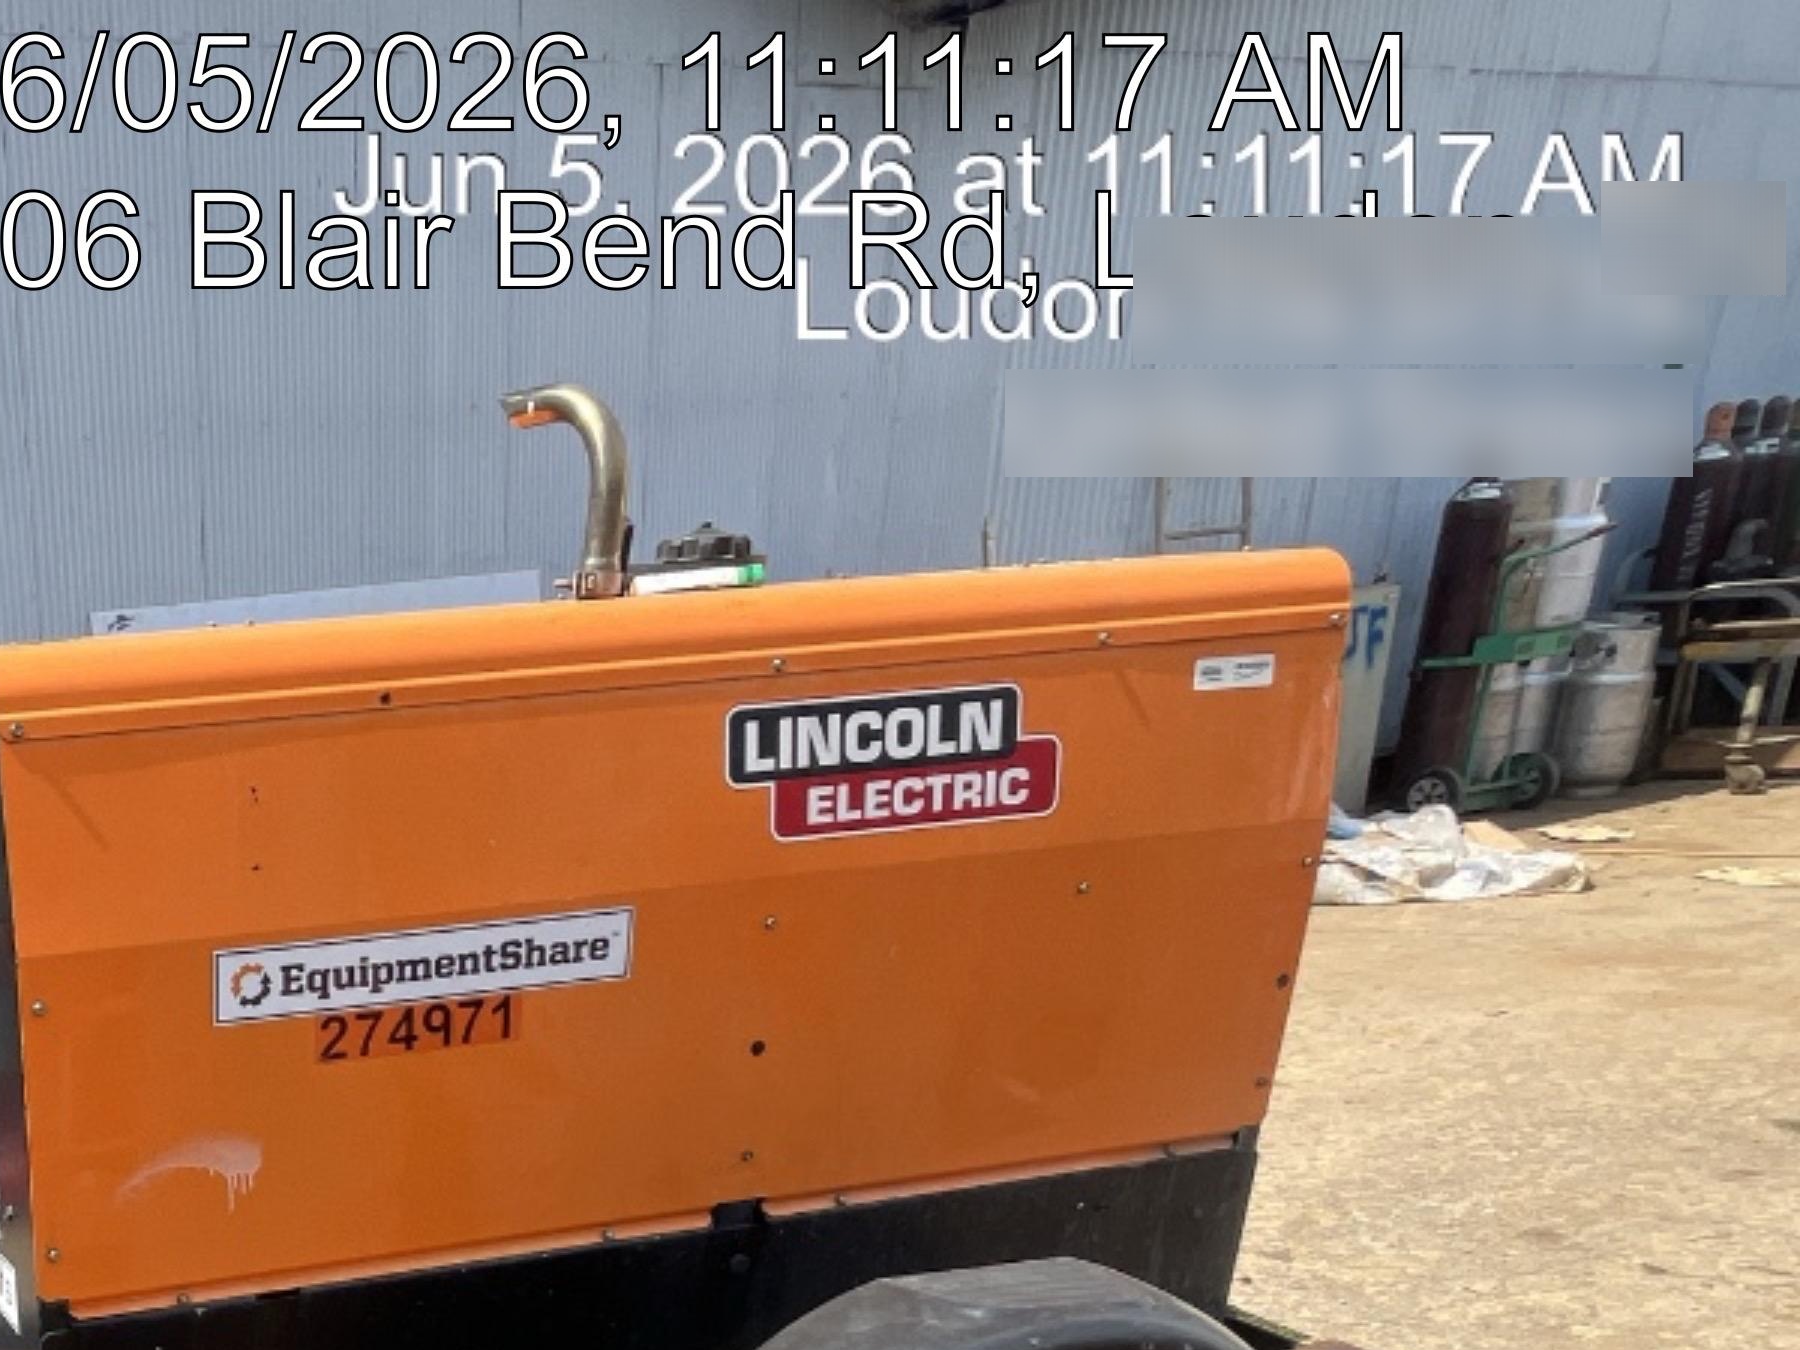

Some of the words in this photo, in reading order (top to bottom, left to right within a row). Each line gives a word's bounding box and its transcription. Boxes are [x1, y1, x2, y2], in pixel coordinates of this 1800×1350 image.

[743, 697, 1005, 774] LINCOLN
[805, 766, 1031, 827] ELECTRIC
[279, 936, 611, 1000] EquipmentShare
[320, 994, 514, 1062] 274971
